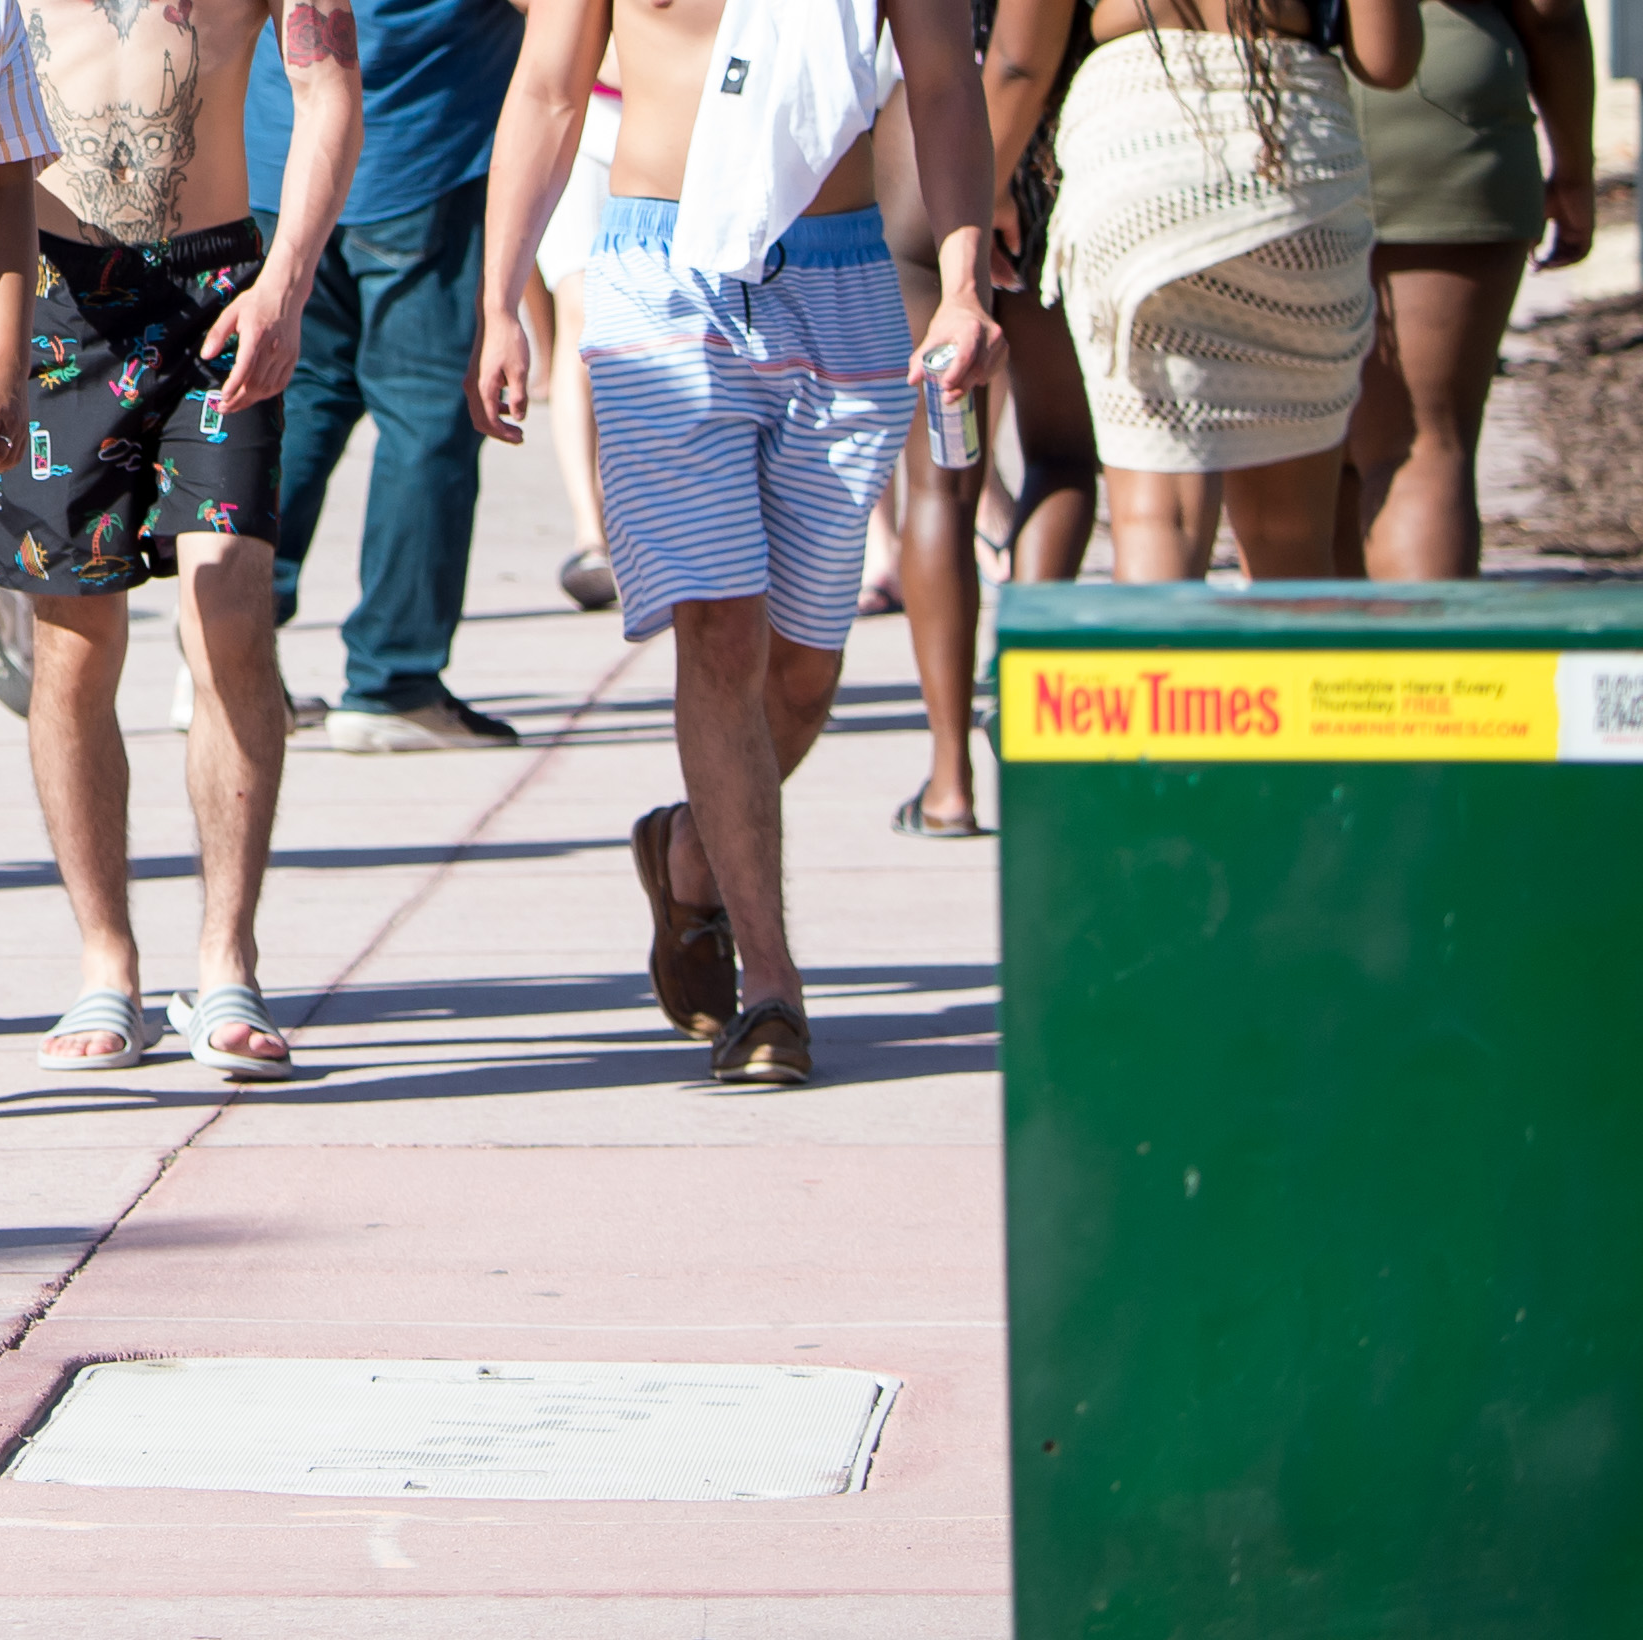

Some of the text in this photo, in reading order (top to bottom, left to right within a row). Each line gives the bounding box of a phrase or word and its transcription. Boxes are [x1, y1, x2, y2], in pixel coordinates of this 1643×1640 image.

[1310, 678, 1506, 700] Available Here Every
[1034, 670, 1281, 736] New Times
[1310, 696, 1453, 716] Thursday FREE
